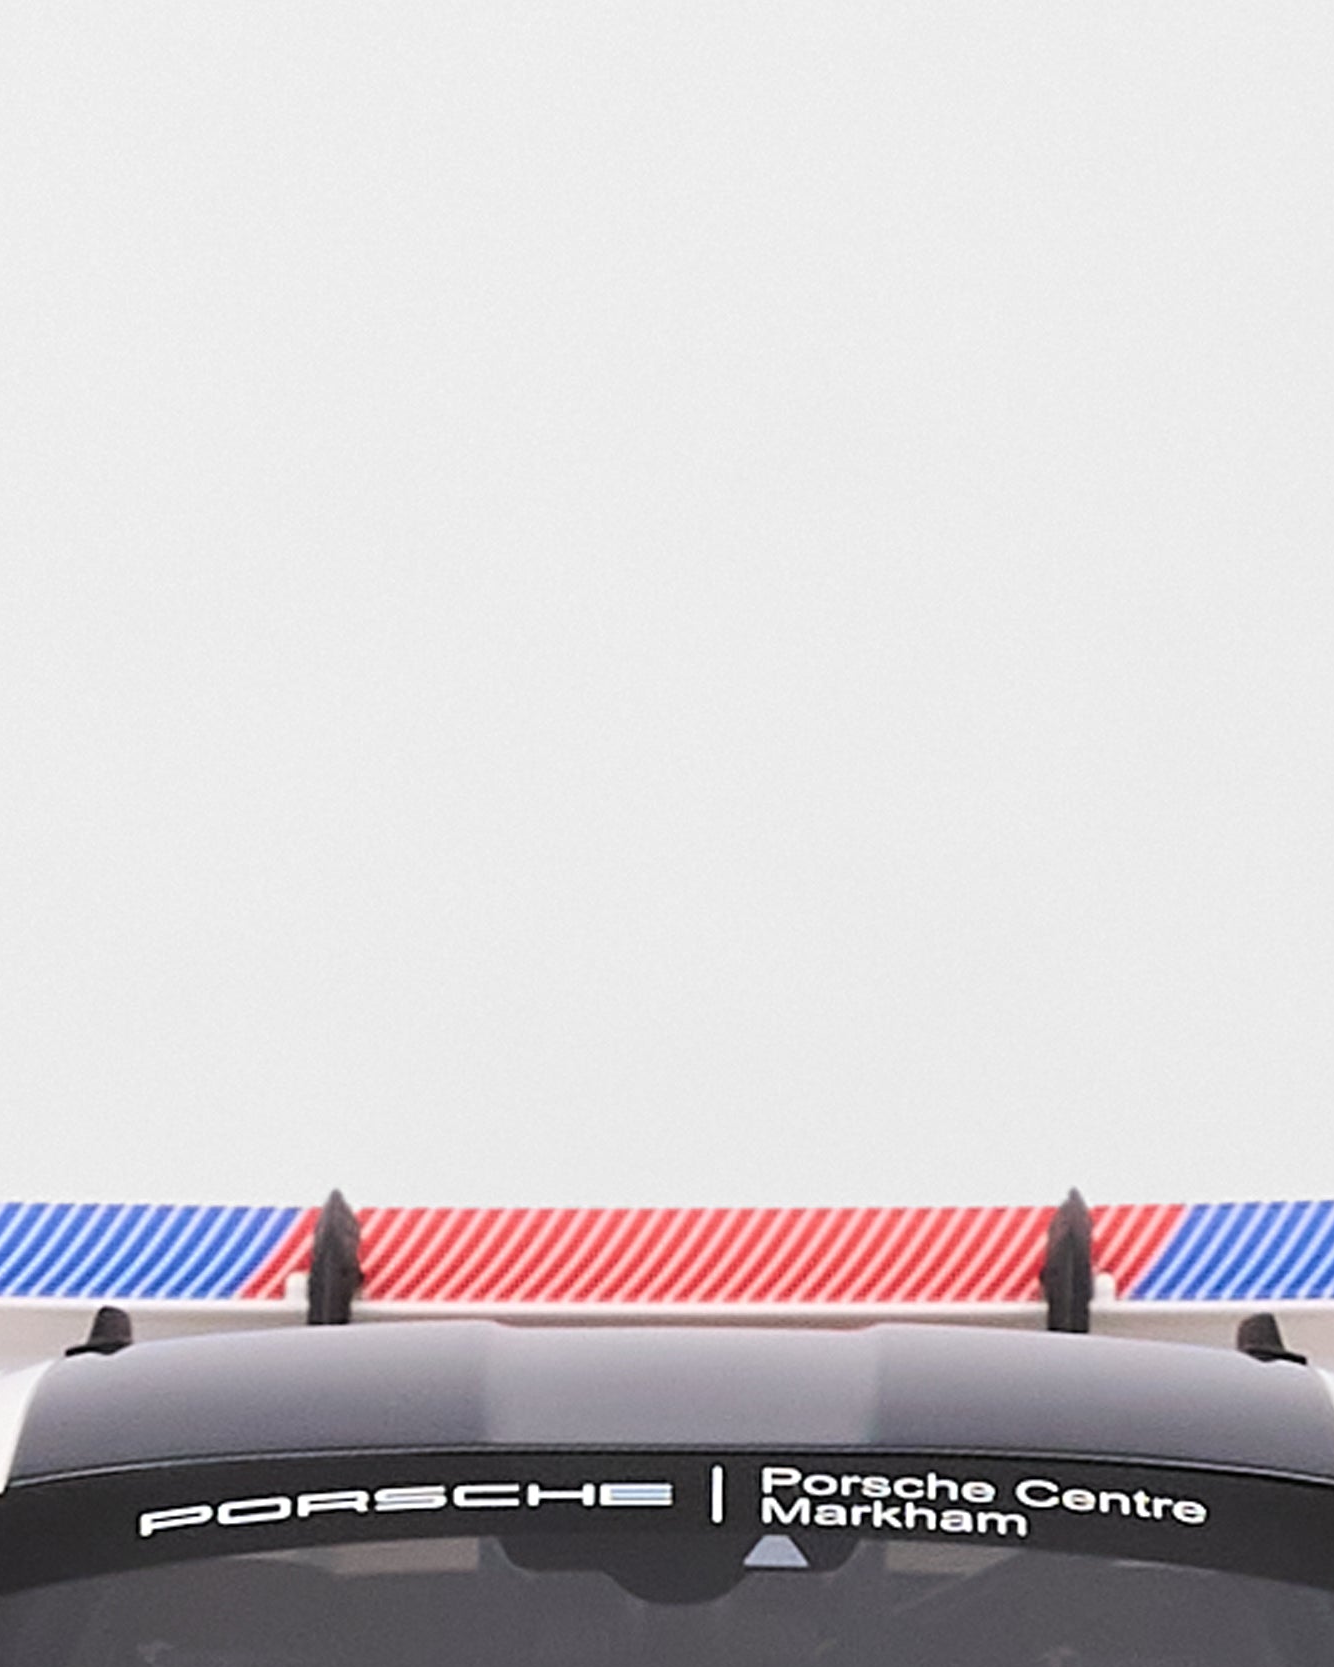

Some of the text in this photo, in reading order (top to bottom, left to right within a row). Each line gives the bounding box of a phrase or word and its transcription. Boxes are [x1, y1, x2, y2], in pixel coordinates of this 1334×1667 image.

[139, 1482, 673, 1537] PORSCHE
[761, 1466, 1207, 1525] Porsche Centre
[761, 1497, 1029, 1537] Markham
